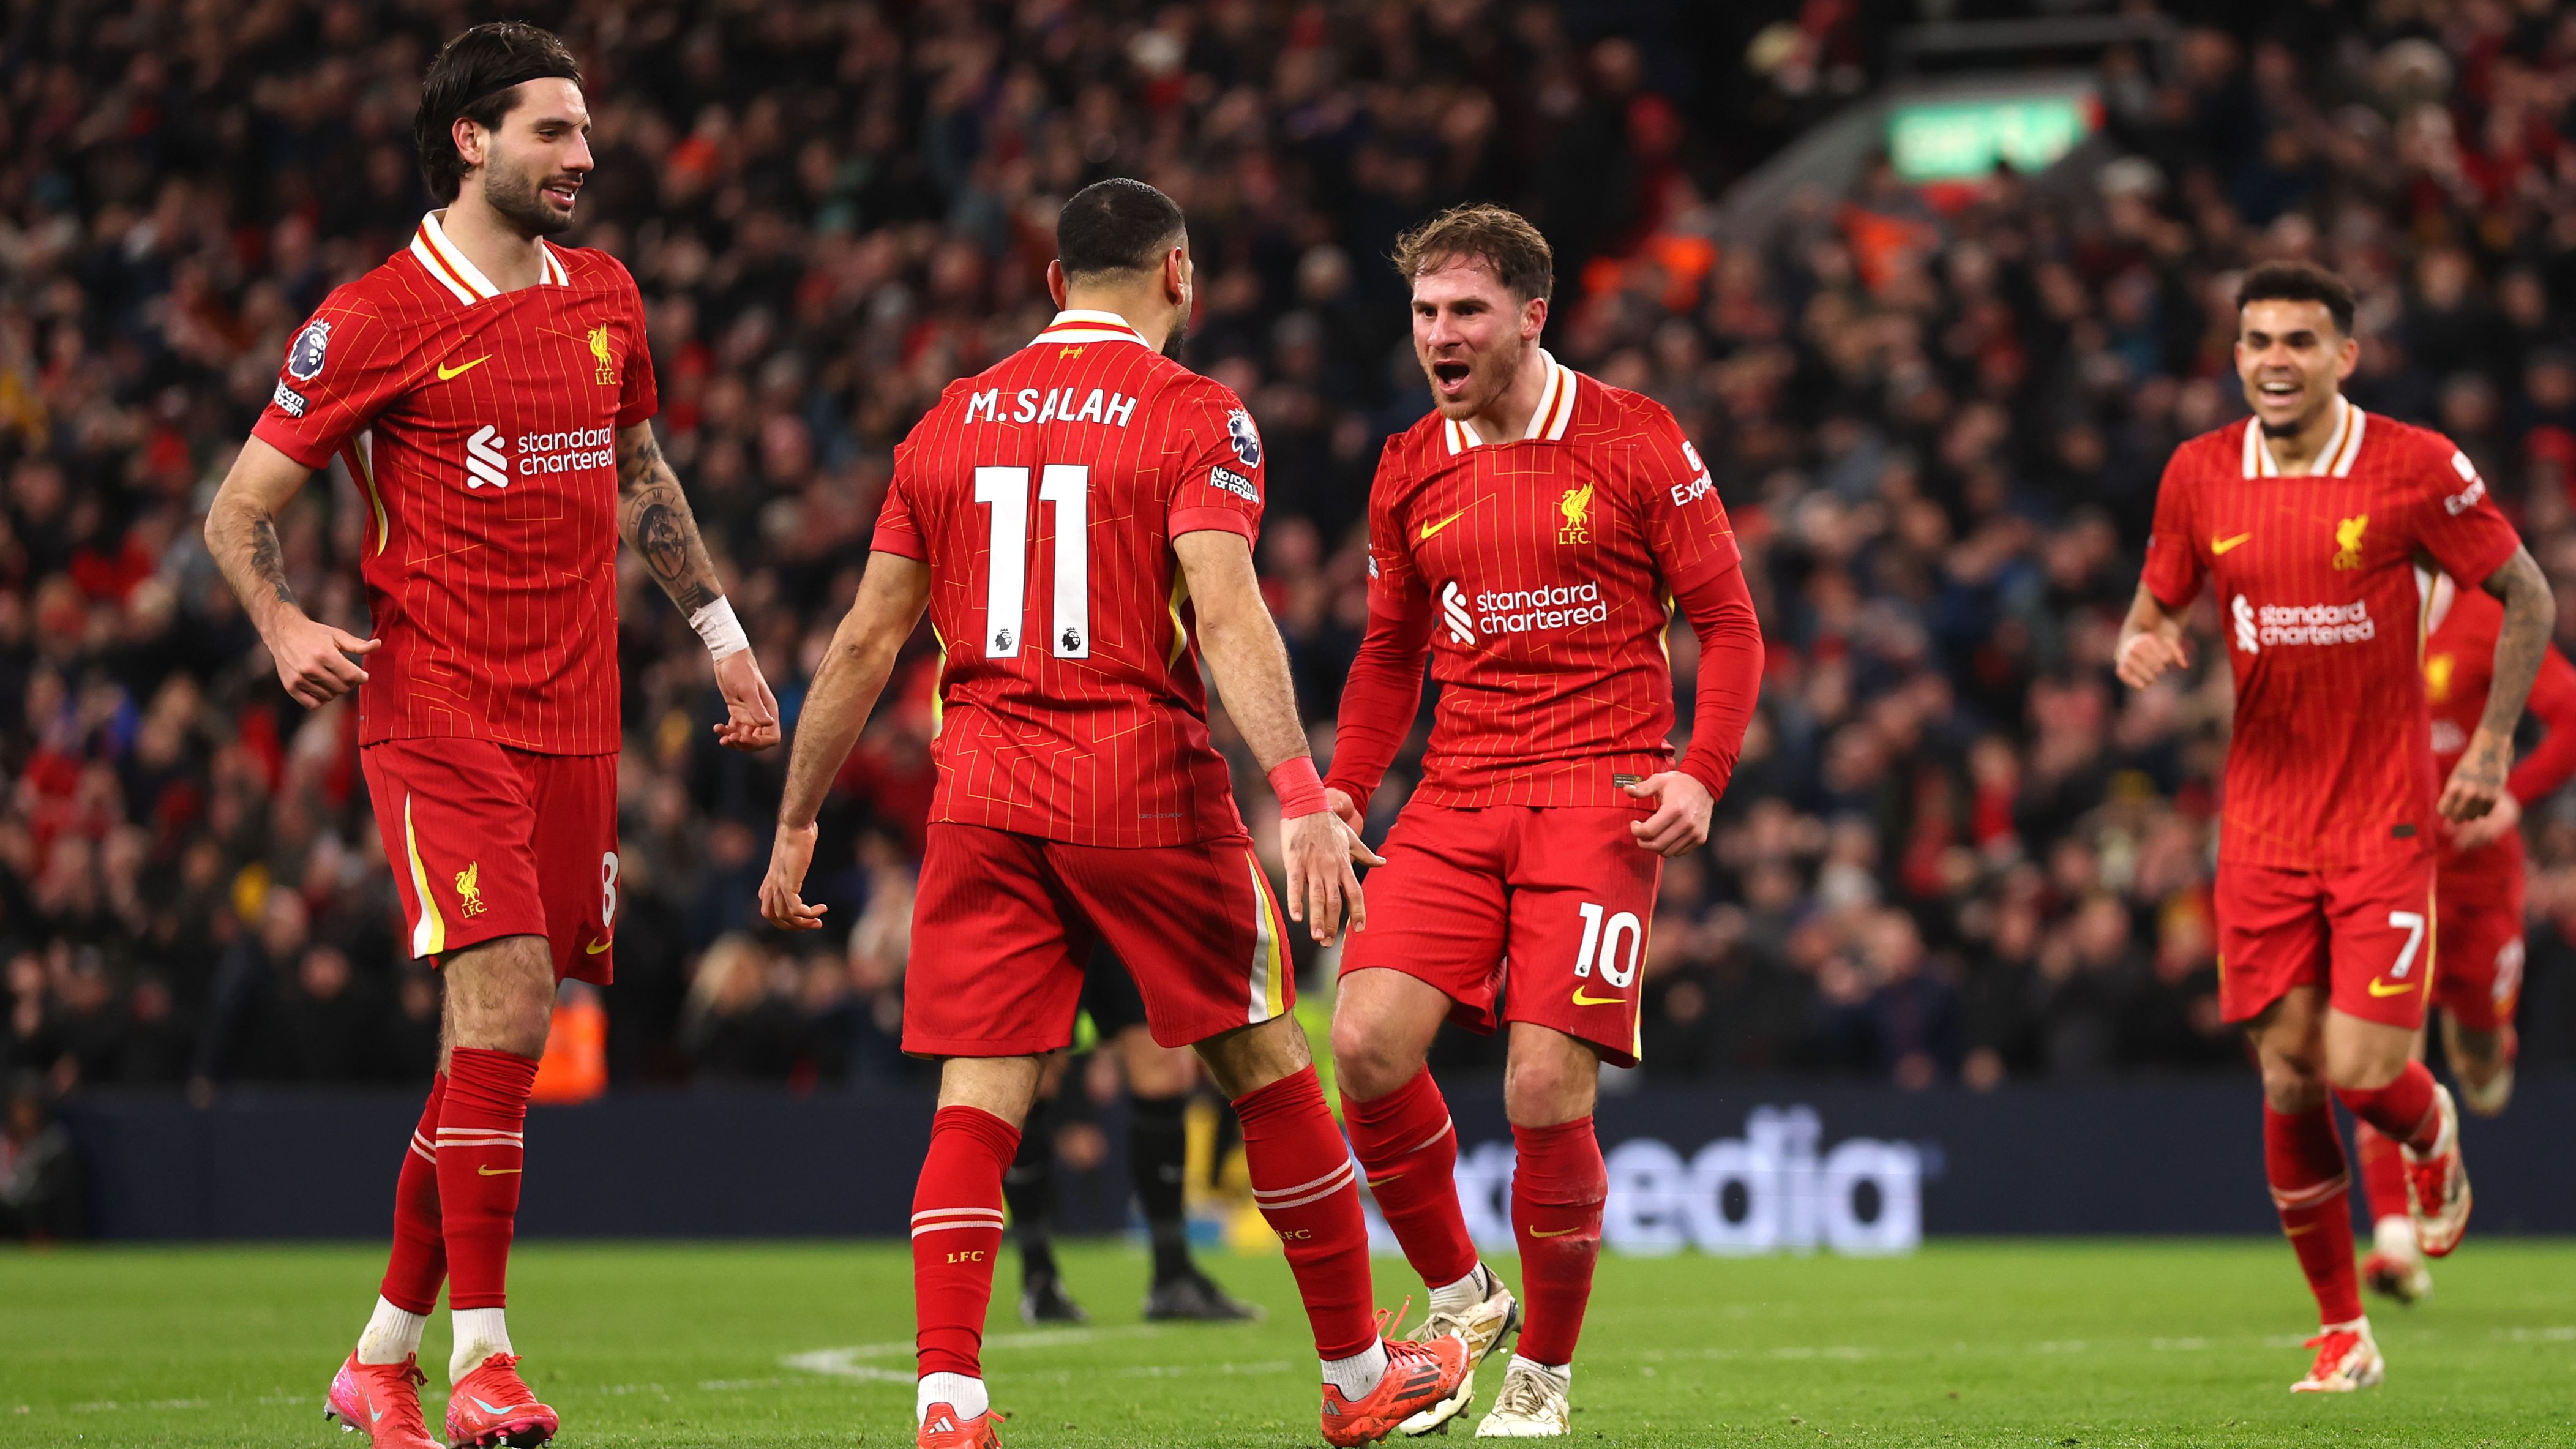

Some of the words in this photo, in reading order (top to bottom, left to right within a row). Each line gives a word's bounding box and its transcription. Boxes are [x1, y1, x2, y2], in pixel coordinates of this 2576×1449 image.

[965, 388, 1137, 427] M.SALAH
[518, 423, 612, 454] standard
[520, 443, 613, 476] chartered
[1210, 476, 1227, 489] for
[1229, 483, 1259, 504] racism
[1211, 466, 1229, 480] No
[1230, 474, 1253, 493] room
[975, 464, 1089, 659] 11
[1477, 580, 1597, 612] standard
[1480, 600, 1607, 634] chartered
[2259, 599, 2367, 626] standard
[2260, 616, 2375, 646] chartered
[602, 851, 618, 928] 8
[1574, 902, 1641, 988] 10
[2389, 910, 2425, 978] 7
[946, 1251, 984, 1264] LFC
